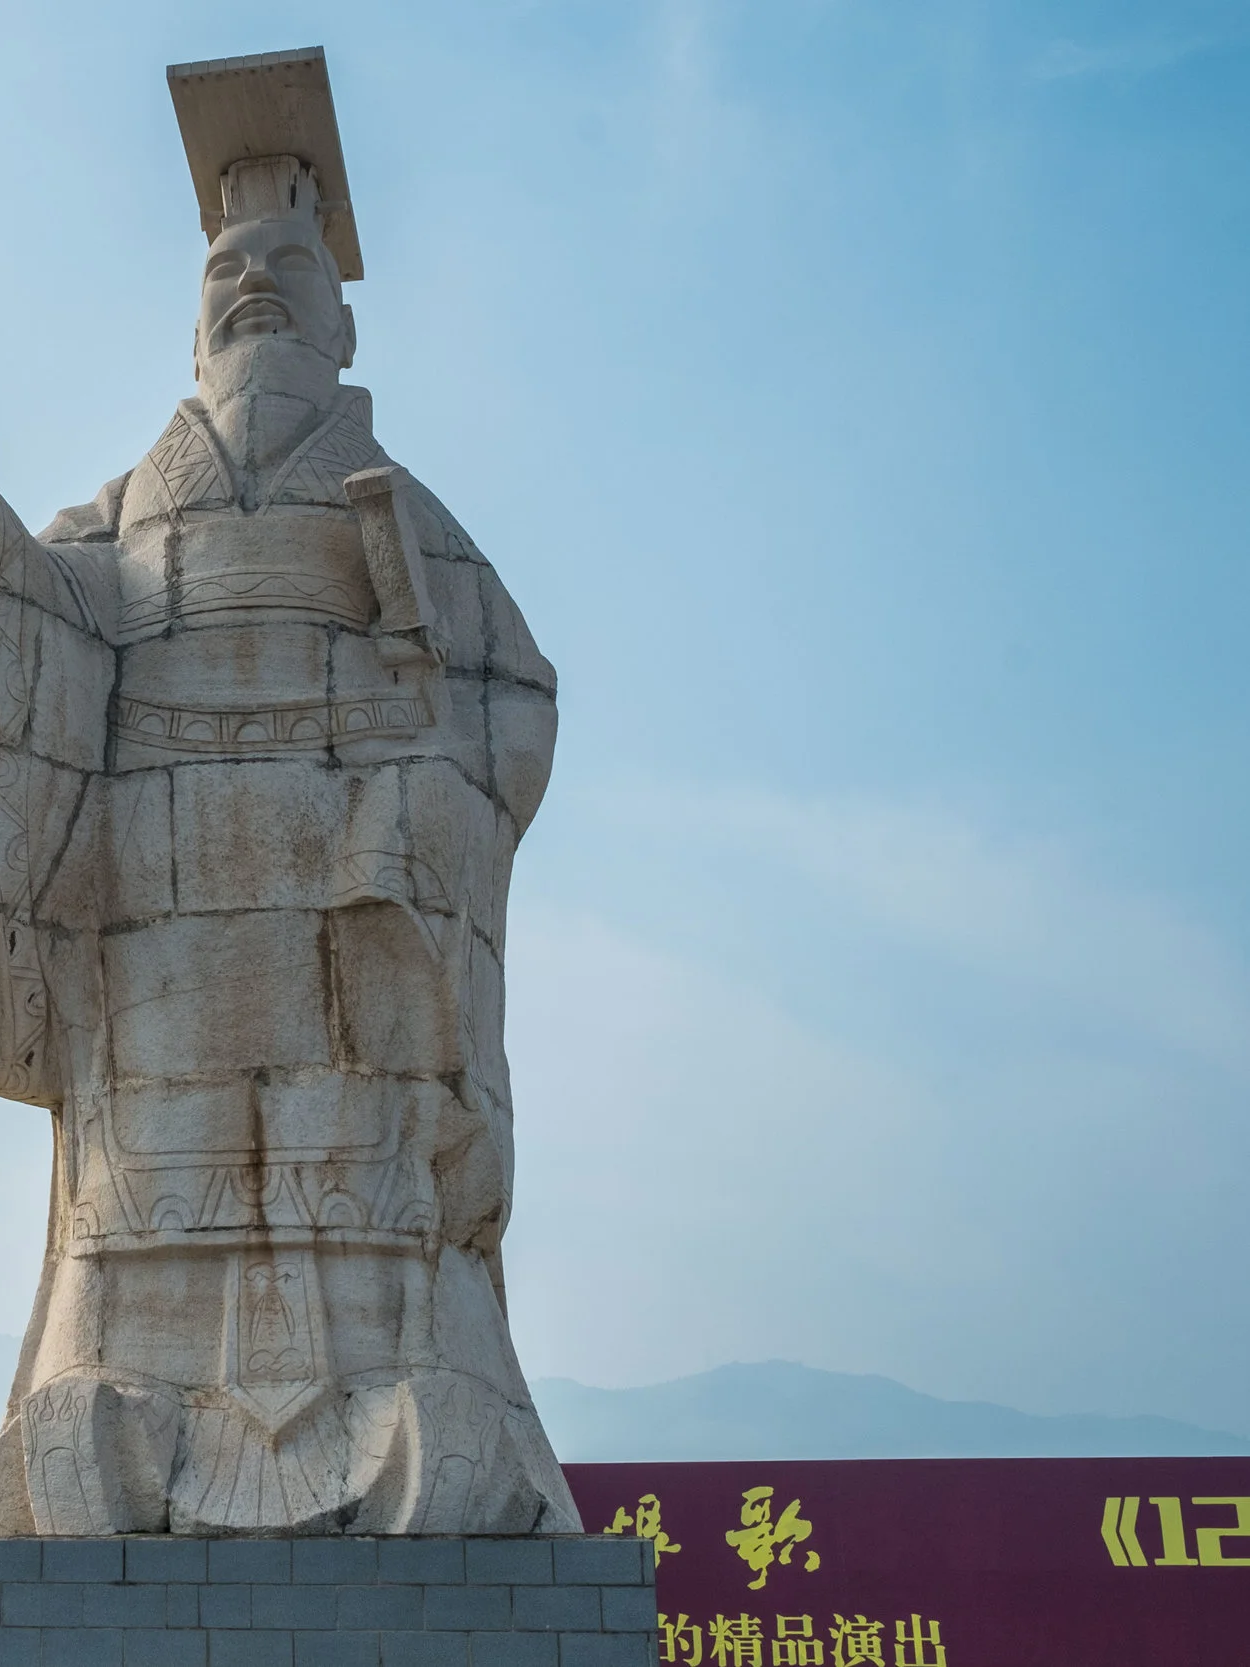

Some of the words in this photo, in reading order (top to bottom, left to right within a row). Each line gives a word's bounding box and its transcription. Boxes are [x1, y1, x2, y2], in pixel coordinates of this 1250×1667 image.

[658, 1613, 946, 1667] 的精品演出
